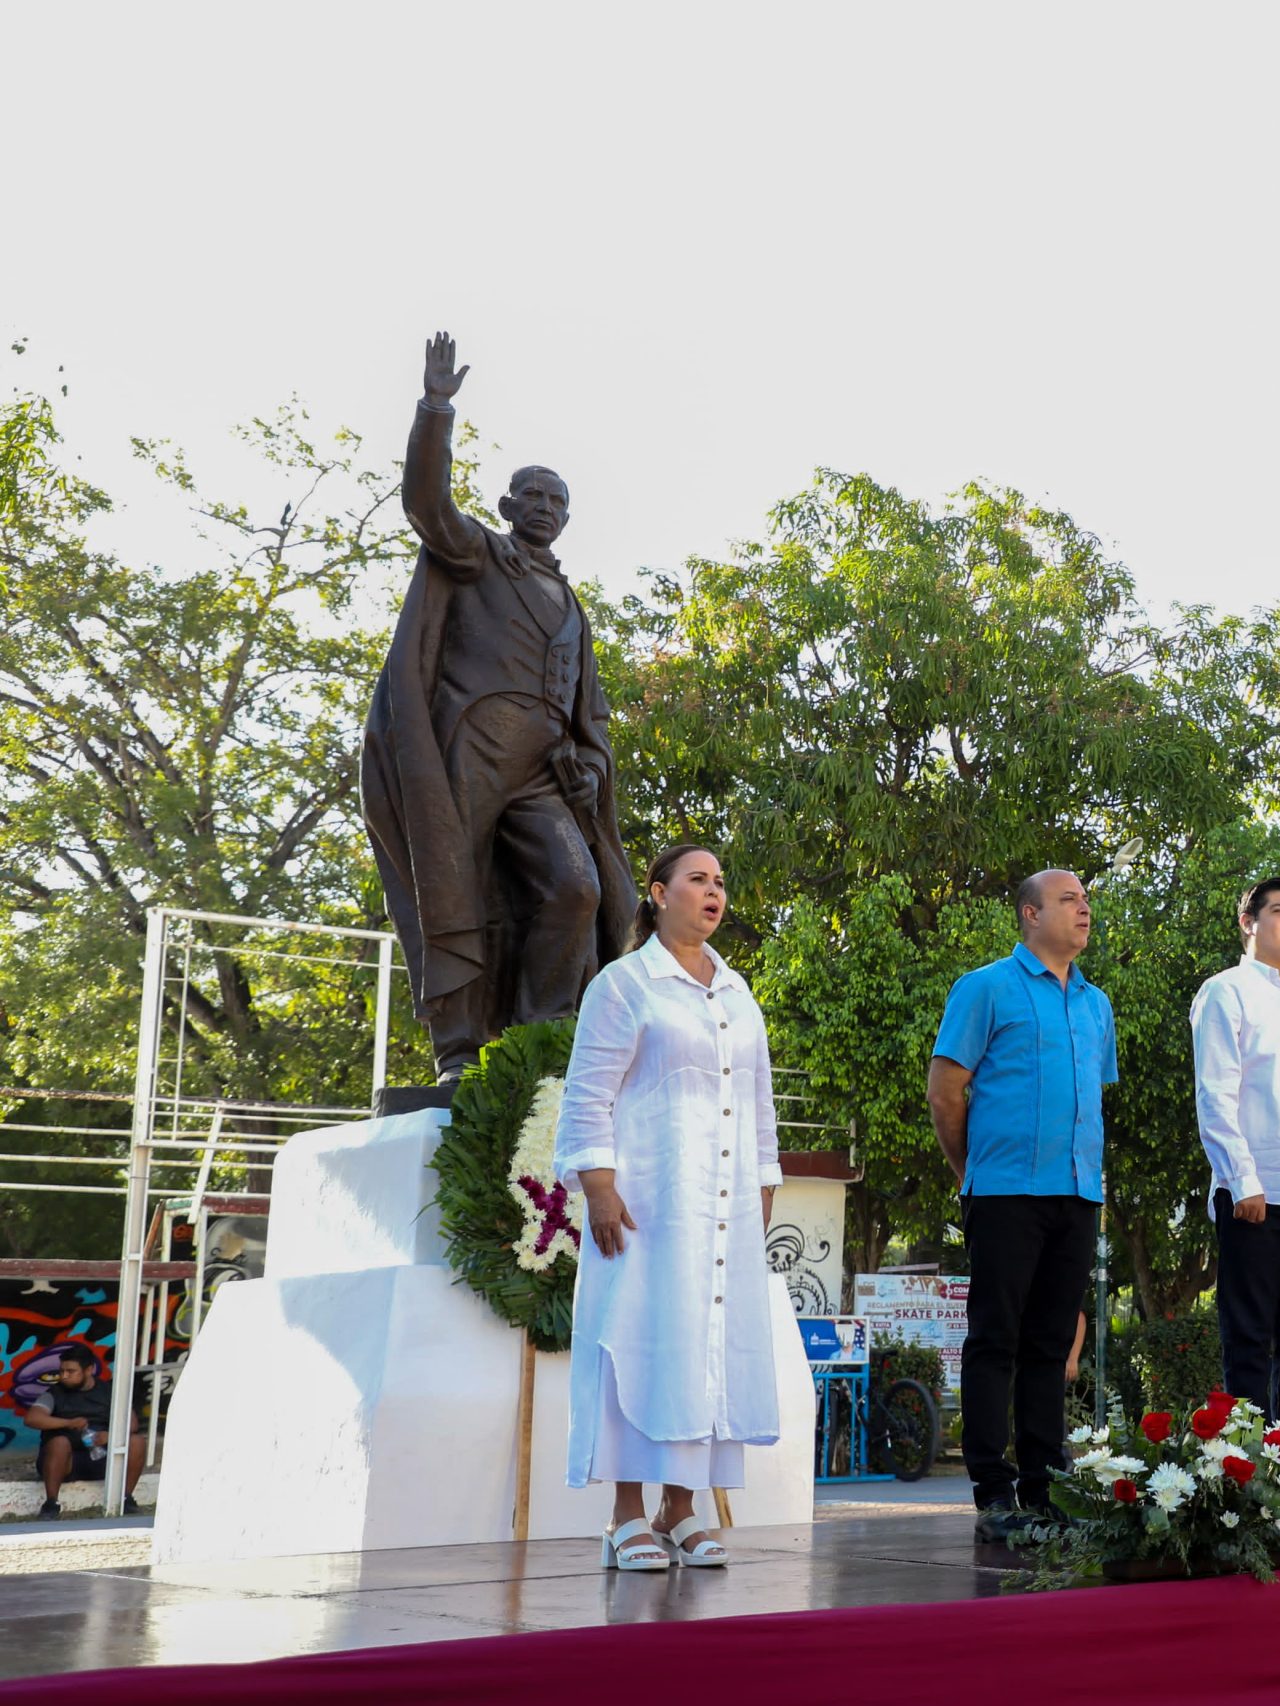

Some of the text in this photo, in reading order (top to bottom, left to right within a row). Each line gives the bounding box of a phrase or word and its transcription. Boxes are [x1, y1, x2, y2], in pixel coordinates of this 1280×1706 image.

[916, 1301, 935, 1309] PARA
[895, 1309, 932, 1319] SKATE
[936, 1310, 968, 1319] PARK
